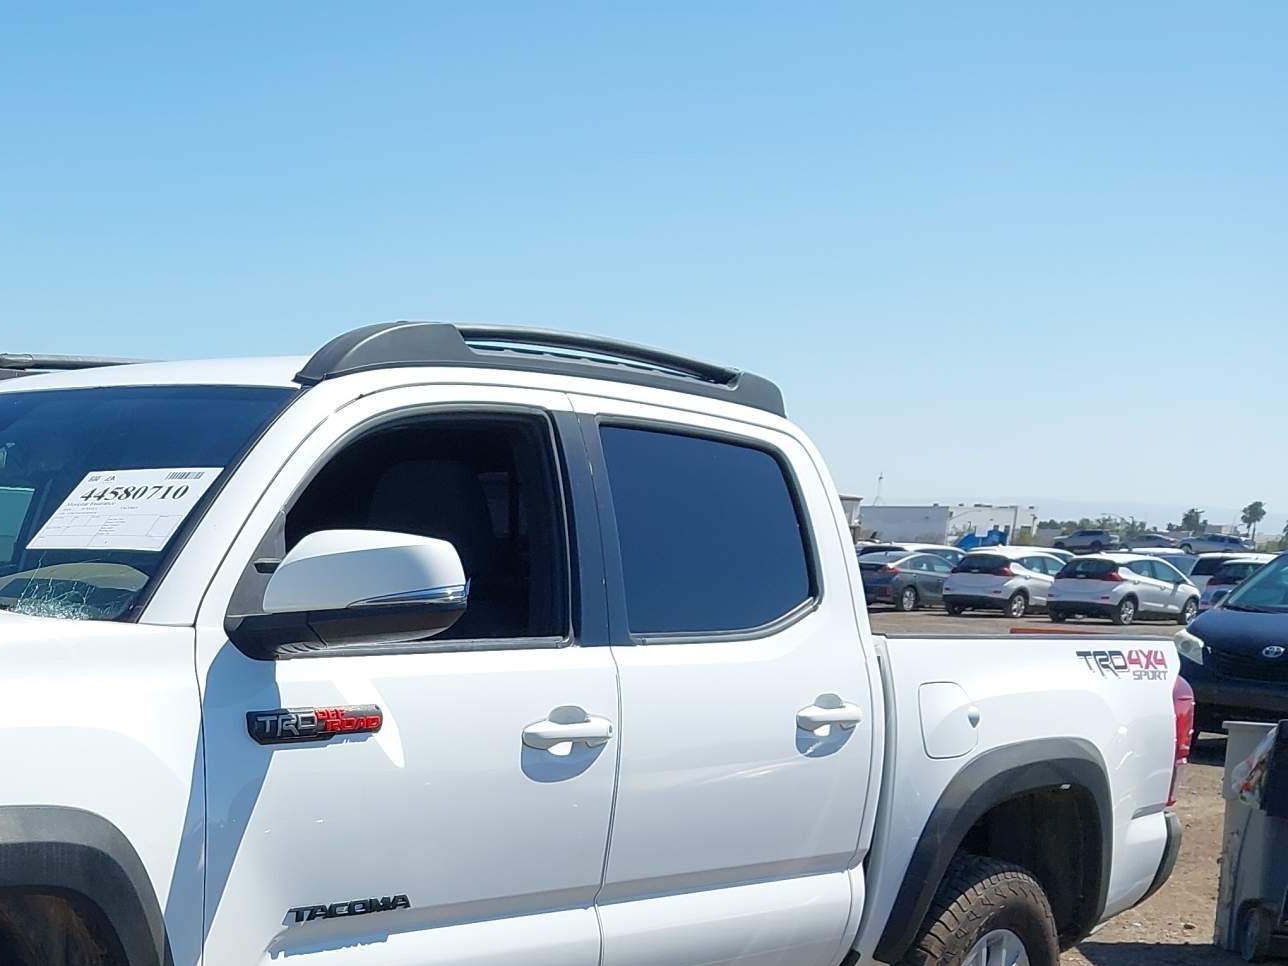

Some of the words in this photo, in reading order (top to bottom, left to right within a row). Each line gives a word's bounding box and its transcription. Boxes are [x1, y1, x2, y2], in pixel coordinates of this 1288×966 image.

[79, 484, 190, 502] 44580710
[1075, 650, 1130, 679] TRD
[1132, 670, 1169, 681] SPORT
[256, 712, 317, 737] TRD
[287, 894, 412, 923] TACOMA
